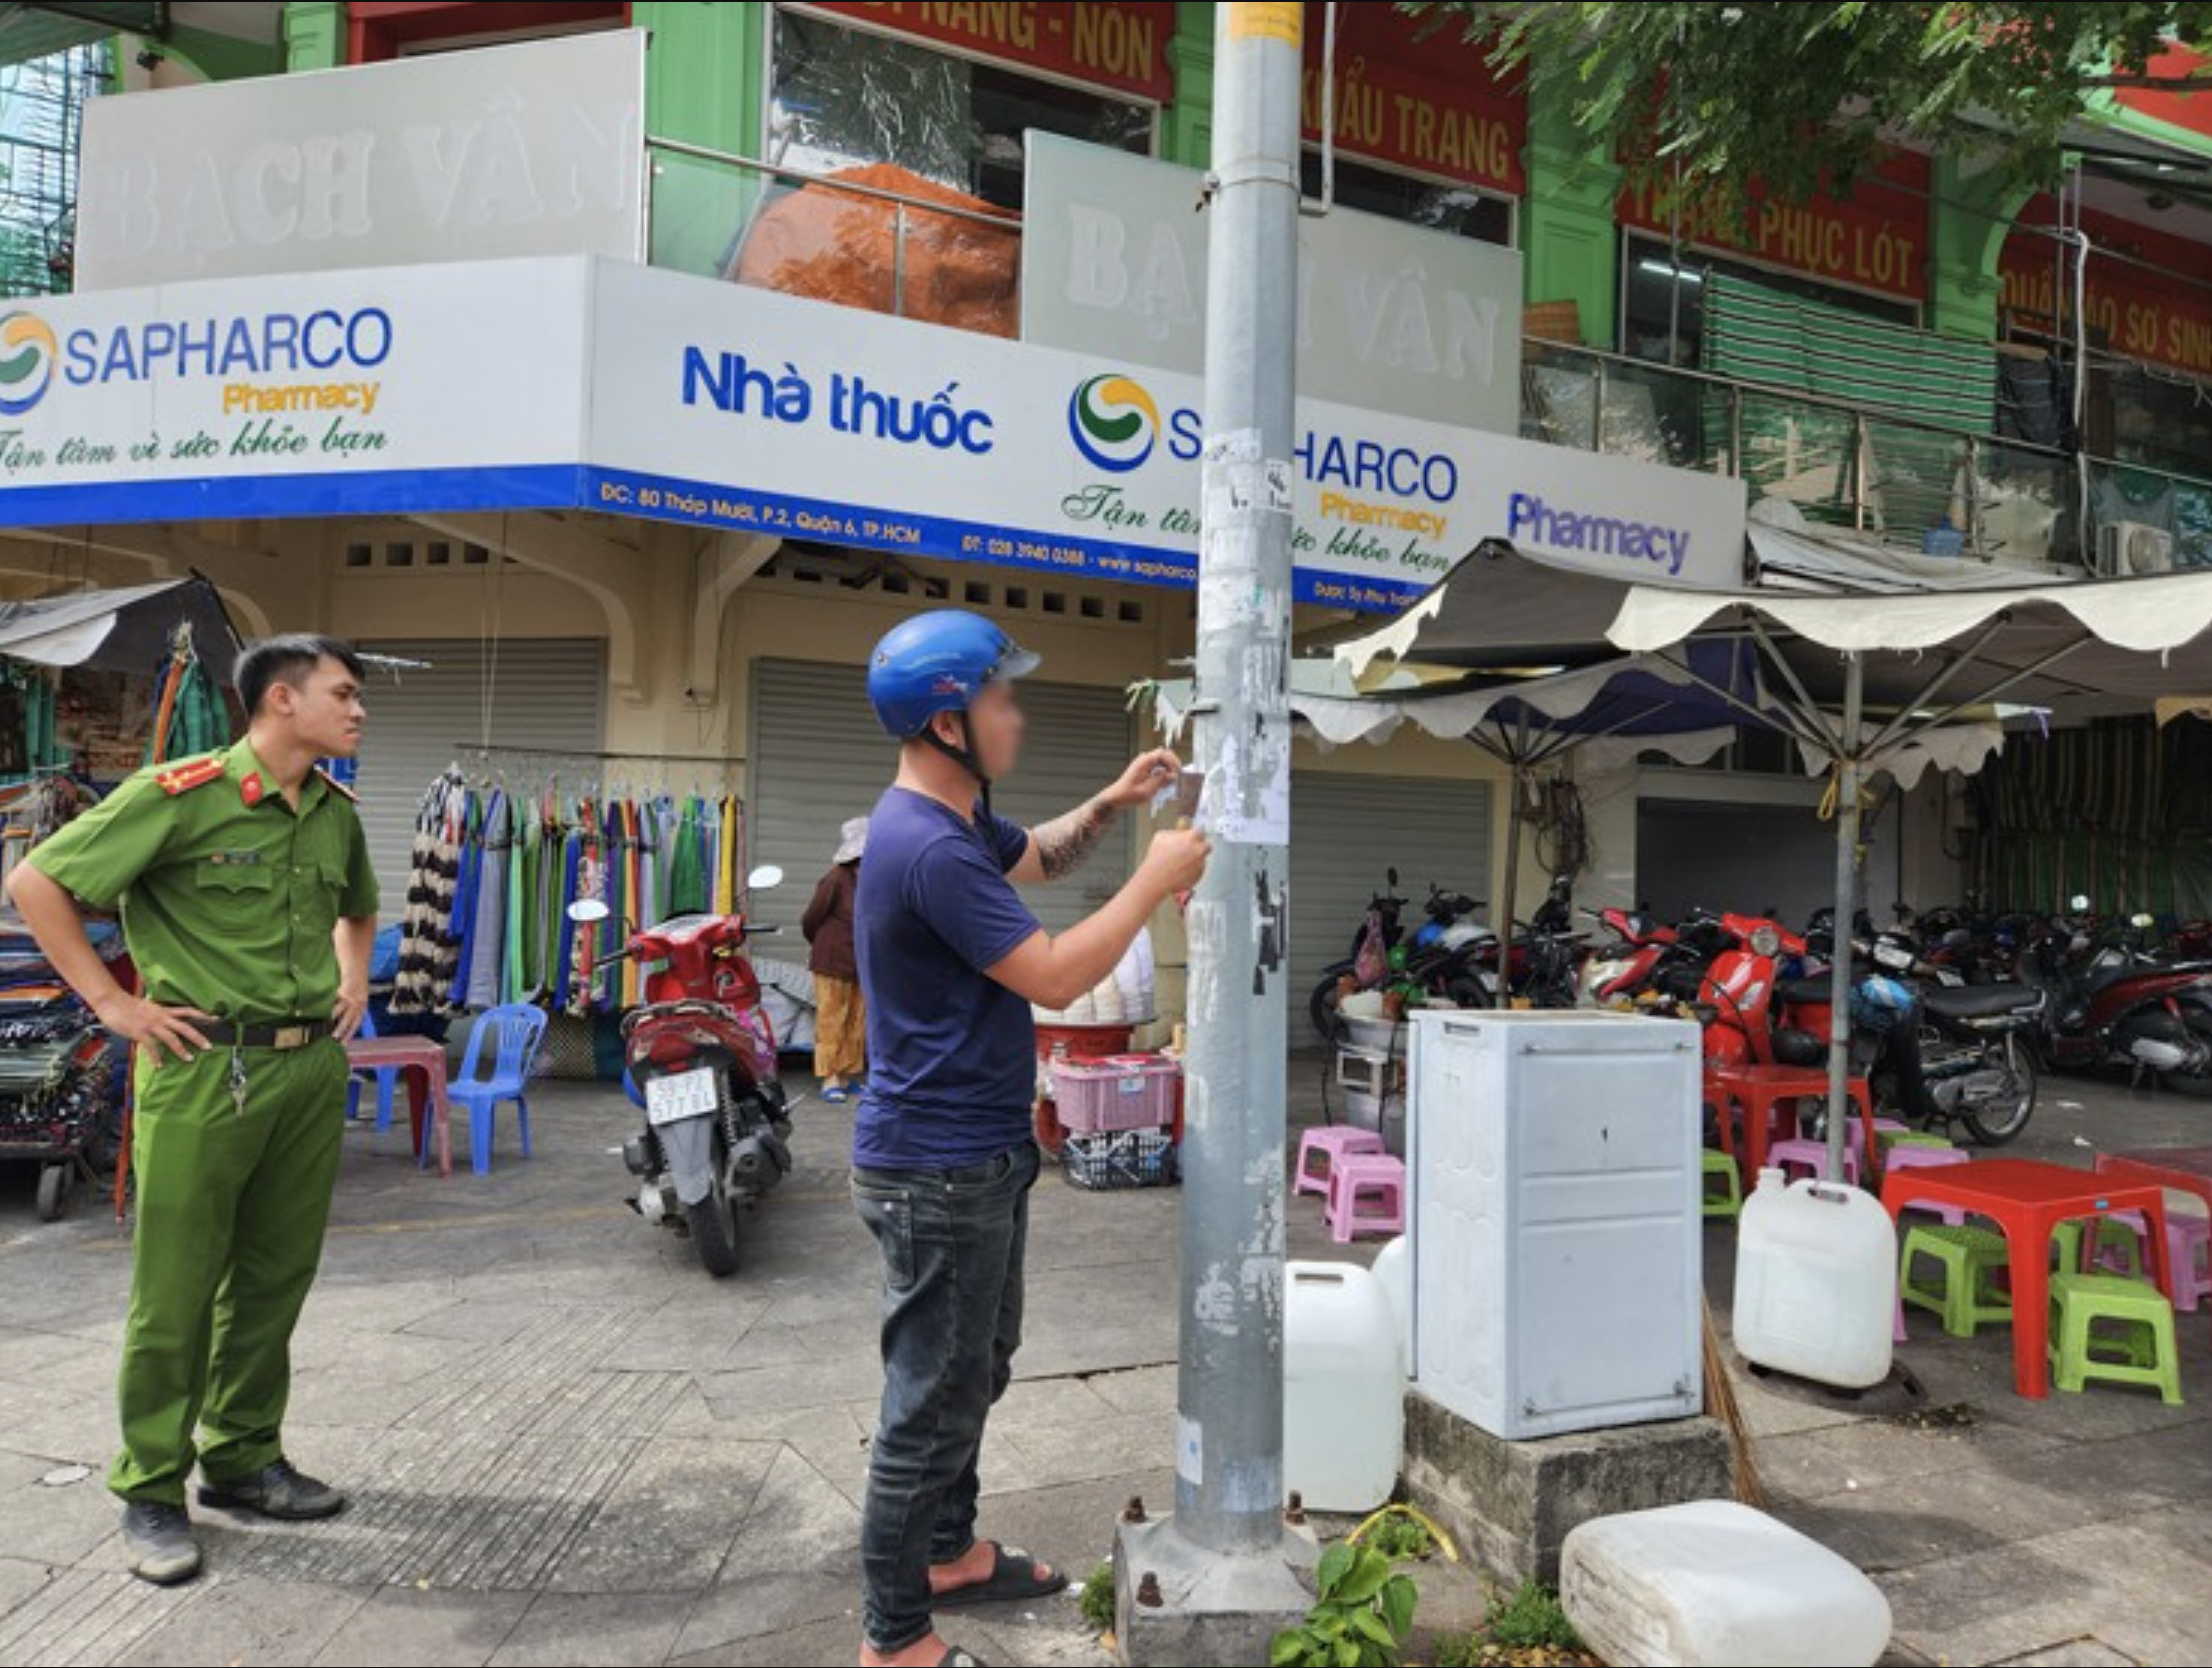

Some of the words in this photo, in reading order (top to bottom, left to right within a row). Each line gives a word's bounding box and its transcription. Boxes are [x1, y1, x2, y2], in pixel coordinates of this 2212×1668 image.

[1394, 94, 1509, 180] TRANG
[1760, 198, 1845, 274] PHỤC
[1855, 220, 1915, 288] LÓT
[64, 307, 393, 386] SAPHARCO
[55, 437, 118, 466] tâm
[129, 431, 161, 462] vì
[169, 430, 220, 460] sức
[229, 415, 309, 458] khỏe
[320, 415, 389, 462] bạn
[222, 380, 381, 416] Pharmacy
[683, 346, 813, 425] Nhà
[829, 373, 995, 455] thuốc
[1168, 407, 1458, 502] SHARCO
[1061, 484, 1148, 531] Tận
[1158, 506, 1200, 535] tâ
[1324, 527, 1390, 563] khỏe
[1399, 537, 1449, 573] bạn
[1320, 491, 1447, 541] Pharmacy
[1508, 492, 1691, 576] Pharmacy
